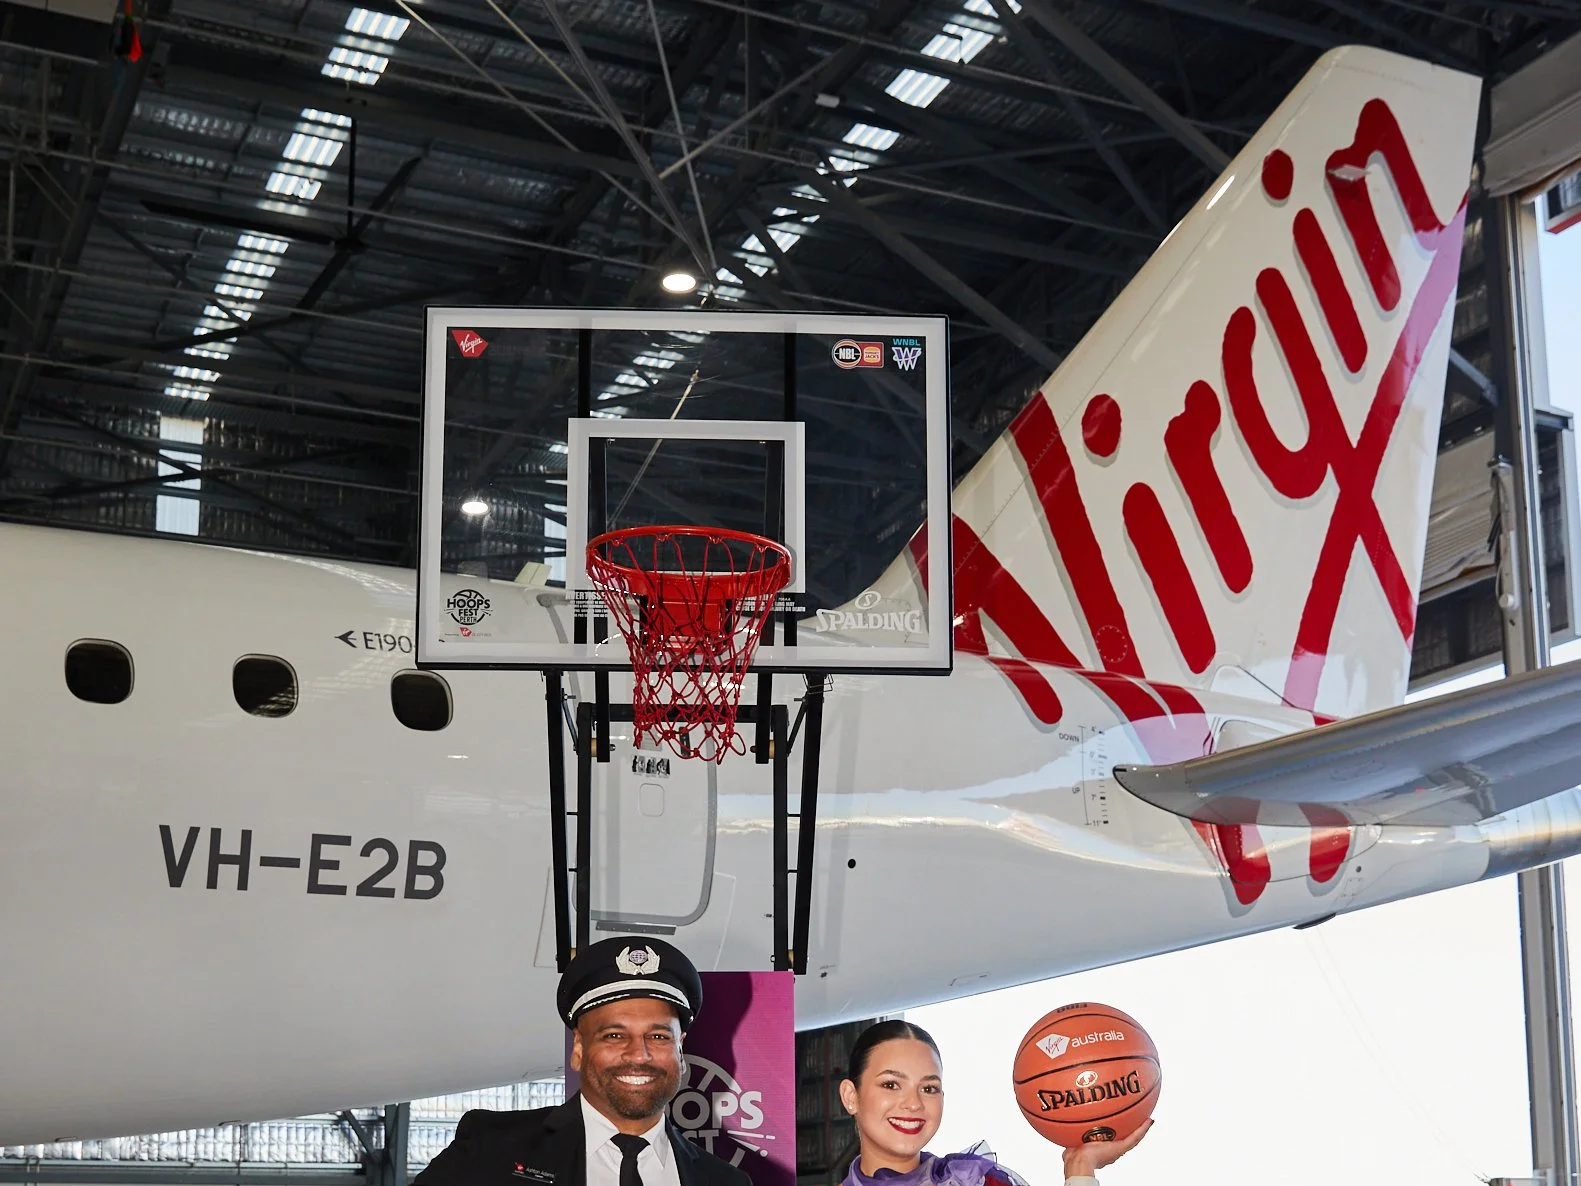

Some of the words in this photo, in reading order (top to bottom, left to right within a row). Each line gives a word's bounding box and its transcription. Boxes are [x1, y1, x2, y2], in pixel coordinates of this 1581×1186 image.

[460, 333, 483, 353] Virgin
[893, 338, 921, 346] WNBL
[839, 347, 856, 360] NBL
[447, 598, 491, 609] HOOPS
[458, 608, 479, 617] FEST
[815, 608, 920, 634] SPALDING
[1058, 732, 1080, 743] DOWN
[158, 823, 448, 901] VH-E2B
[1071, 1030, 1125, 1048] australia
[1037, 1070, 1141, 1112] SPALDING
